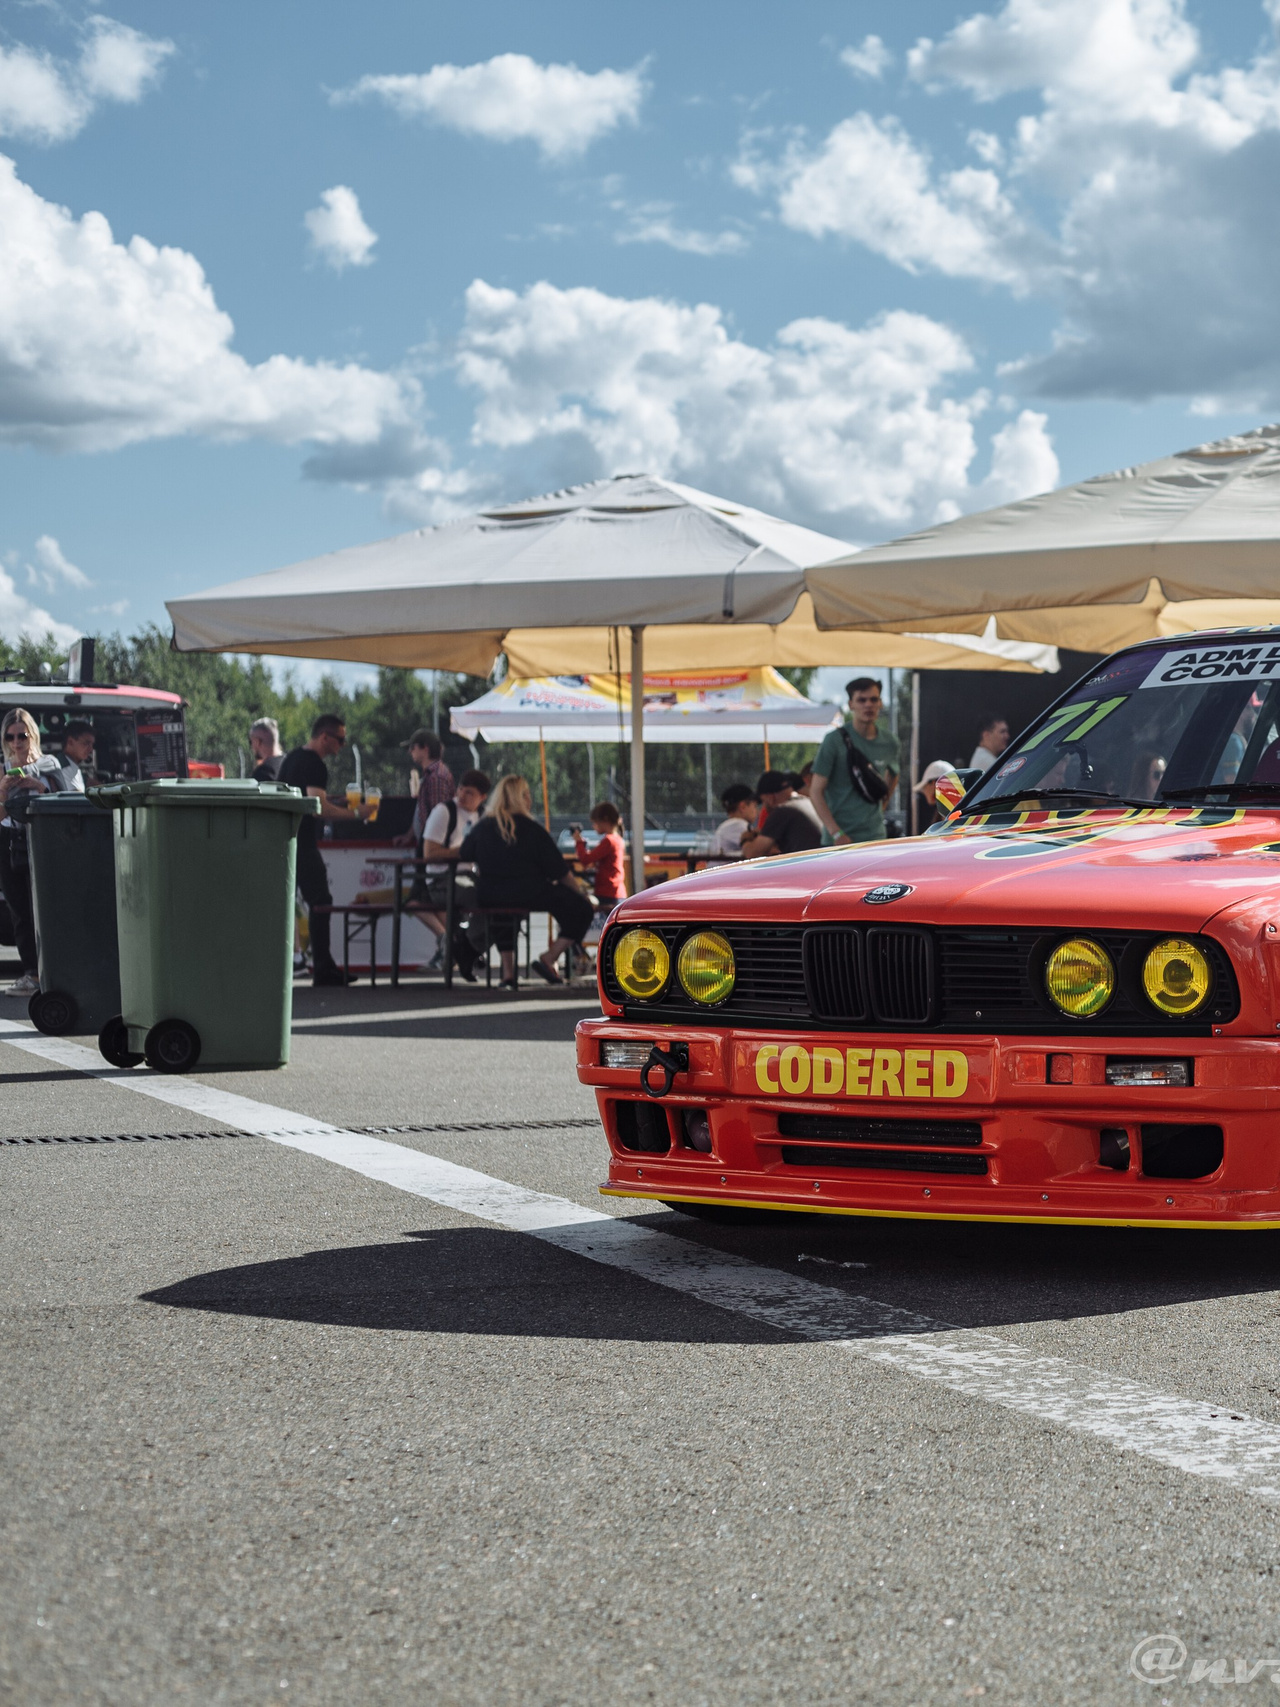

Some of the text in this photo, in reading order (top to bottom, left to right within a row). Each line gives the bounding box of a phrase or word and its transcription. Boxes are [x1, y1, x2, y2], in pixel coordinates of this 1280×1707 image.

[1170, 647, 1263, 667] ADM
[1017, 696, 1128, 754] 71
[755, 1045, 969, 1098] CODERED
